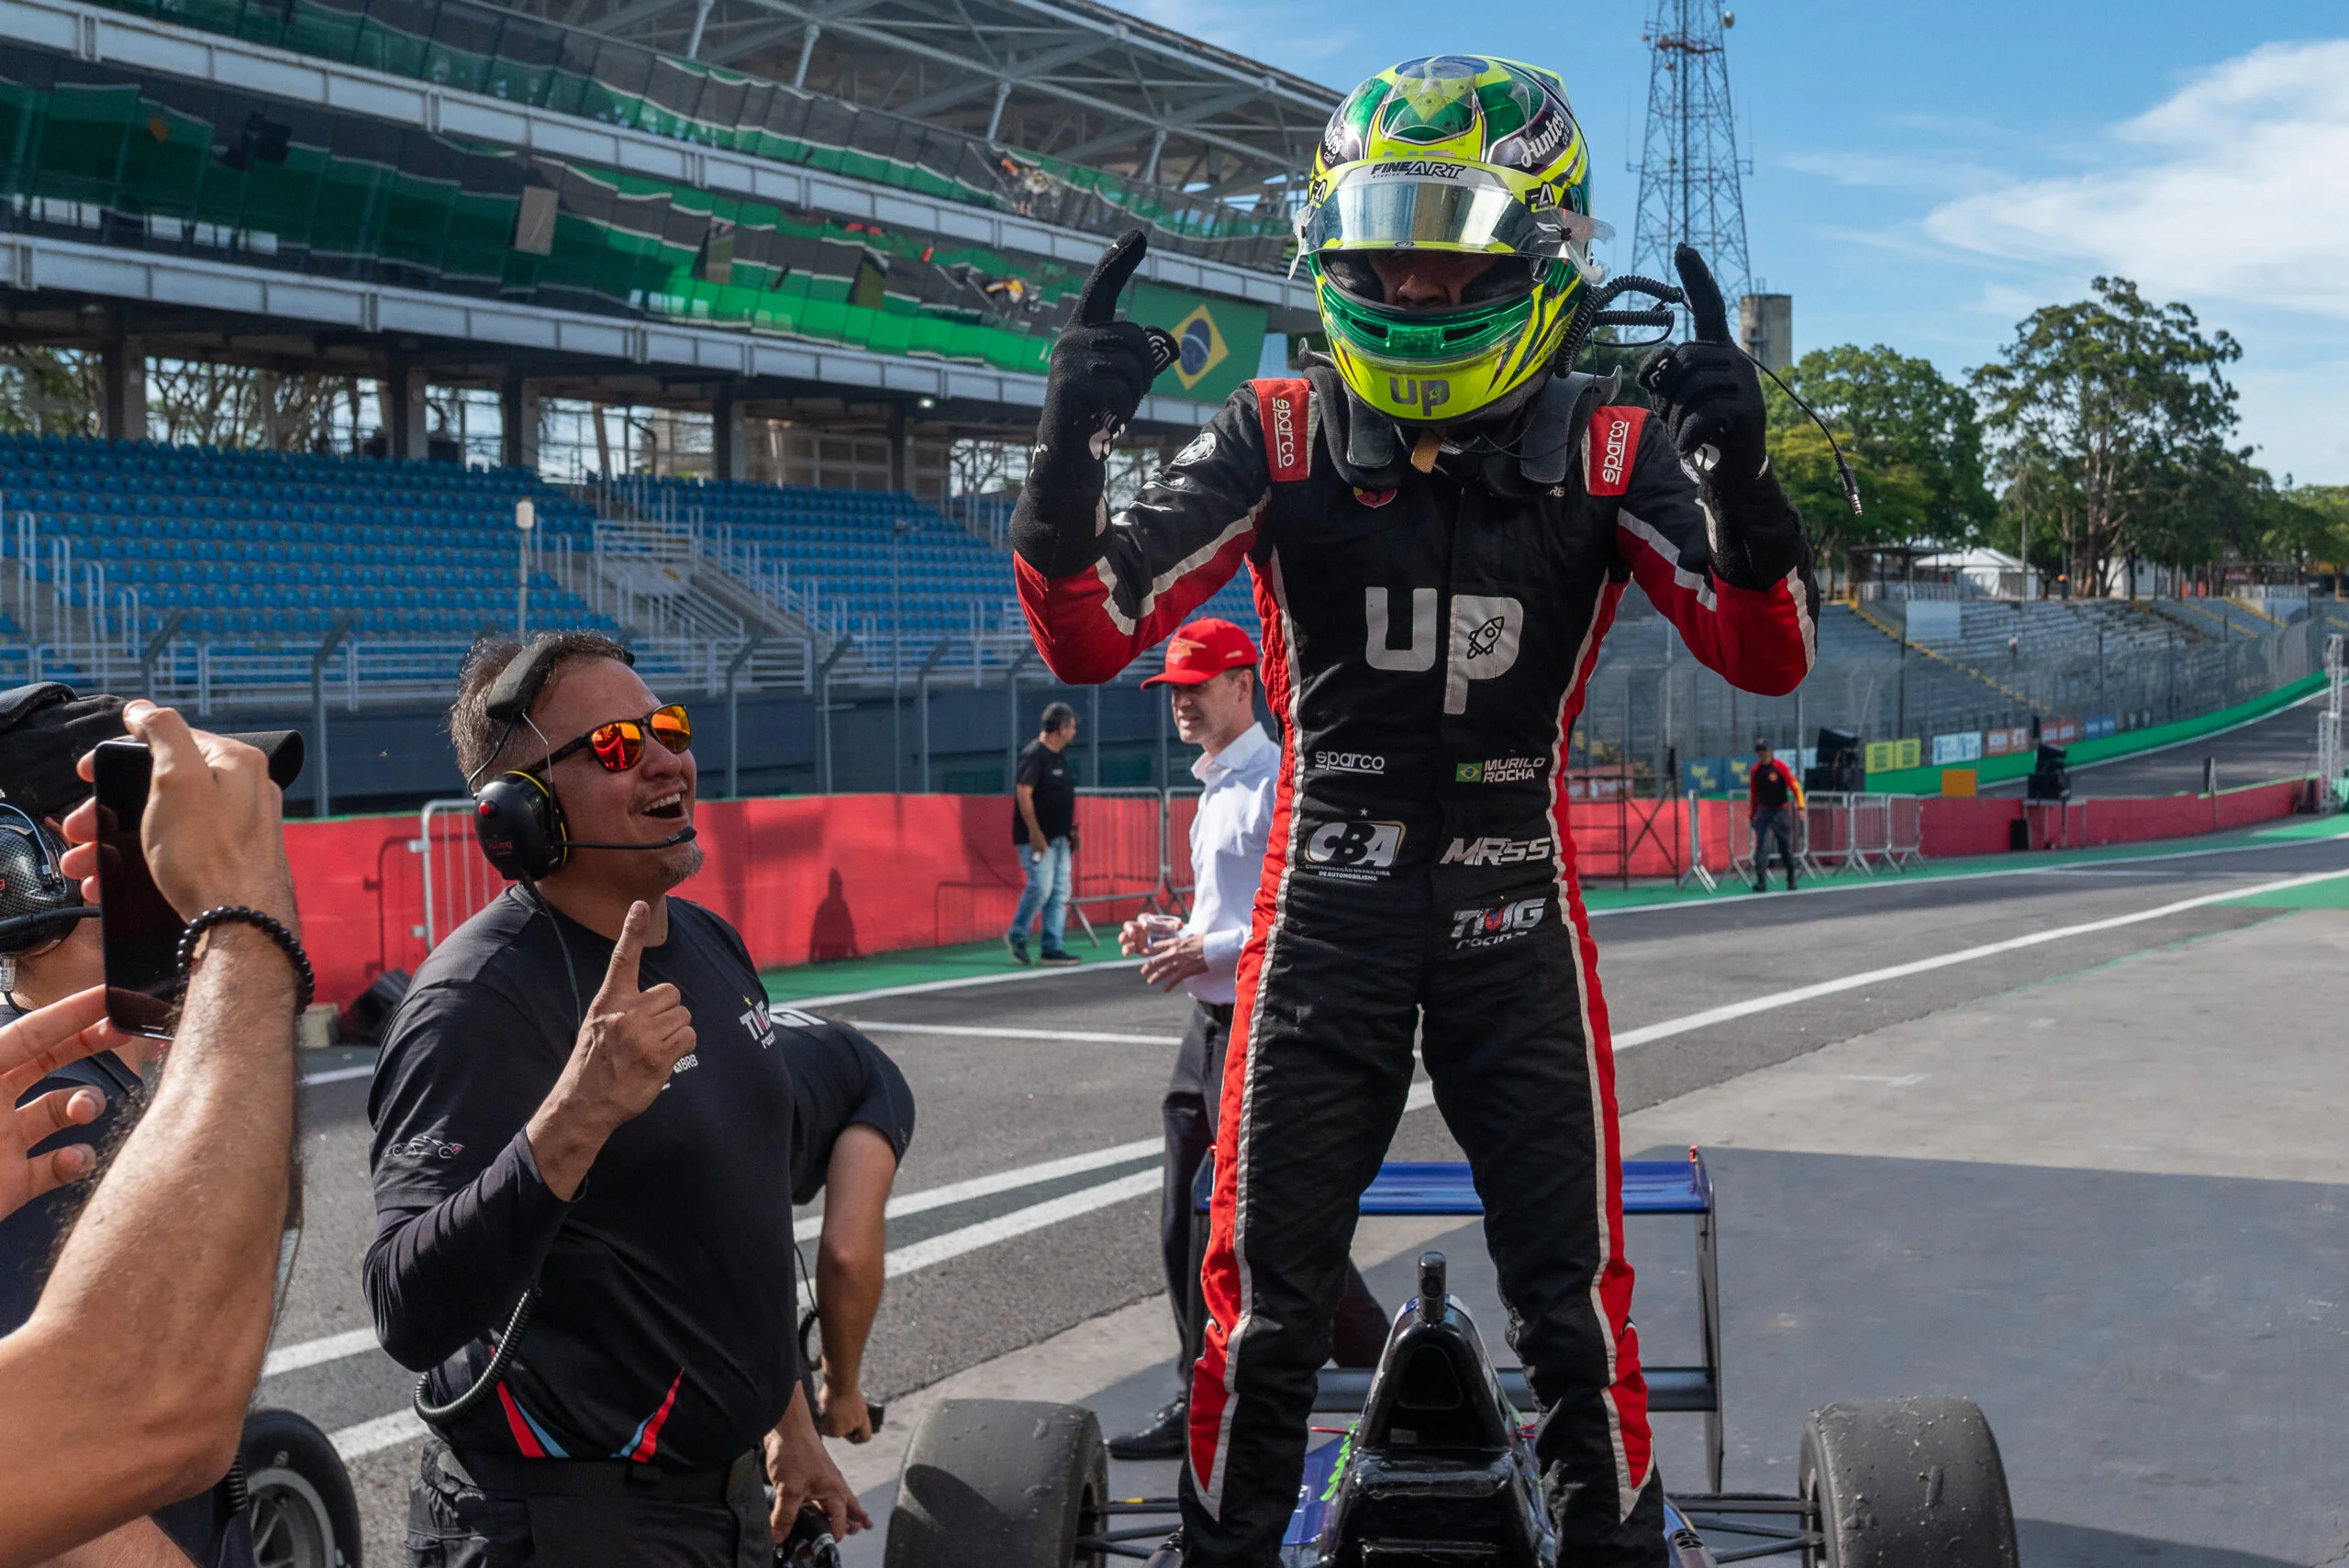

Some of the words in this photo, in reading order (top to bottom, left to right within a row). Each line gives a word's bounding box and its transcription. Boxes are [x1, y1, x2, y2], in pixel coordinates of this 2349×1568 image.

[1512, 110, 1564, 168] Juntos
[1272, 397, 1295, 469] sparco
[1602, 420, 1630, 484] sparco
[1315, 751, 1385, 774] sparco
[1484, 757, 1546, 772] MURILO
[1483, 768, 1535, 784] ROCHA
[1308, 822, 1401, 867] CBA
[1327, 871, 1378, 882] AUTOMOBILISMO
[679, 1053, 698, 1071] BRB
